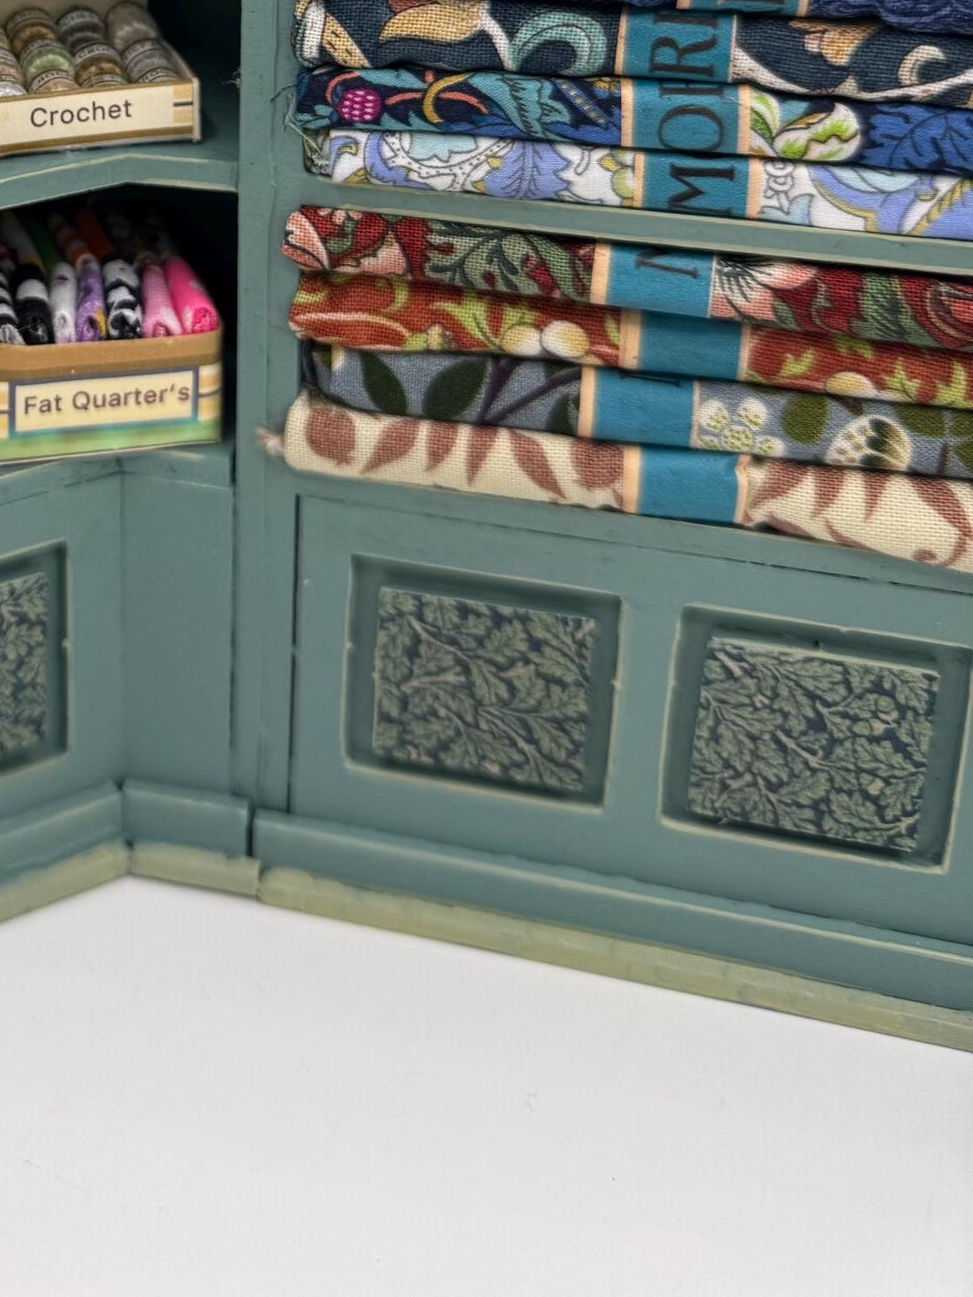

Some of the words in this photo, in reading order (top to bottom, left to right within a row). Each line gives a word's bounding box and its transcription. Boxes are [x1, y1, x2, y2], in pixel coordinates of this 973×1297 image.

[30, 99, 132, 127] Crochet
[24, 393, 63, 415] Fat
[72, 383, 190, 411] Quarter's
